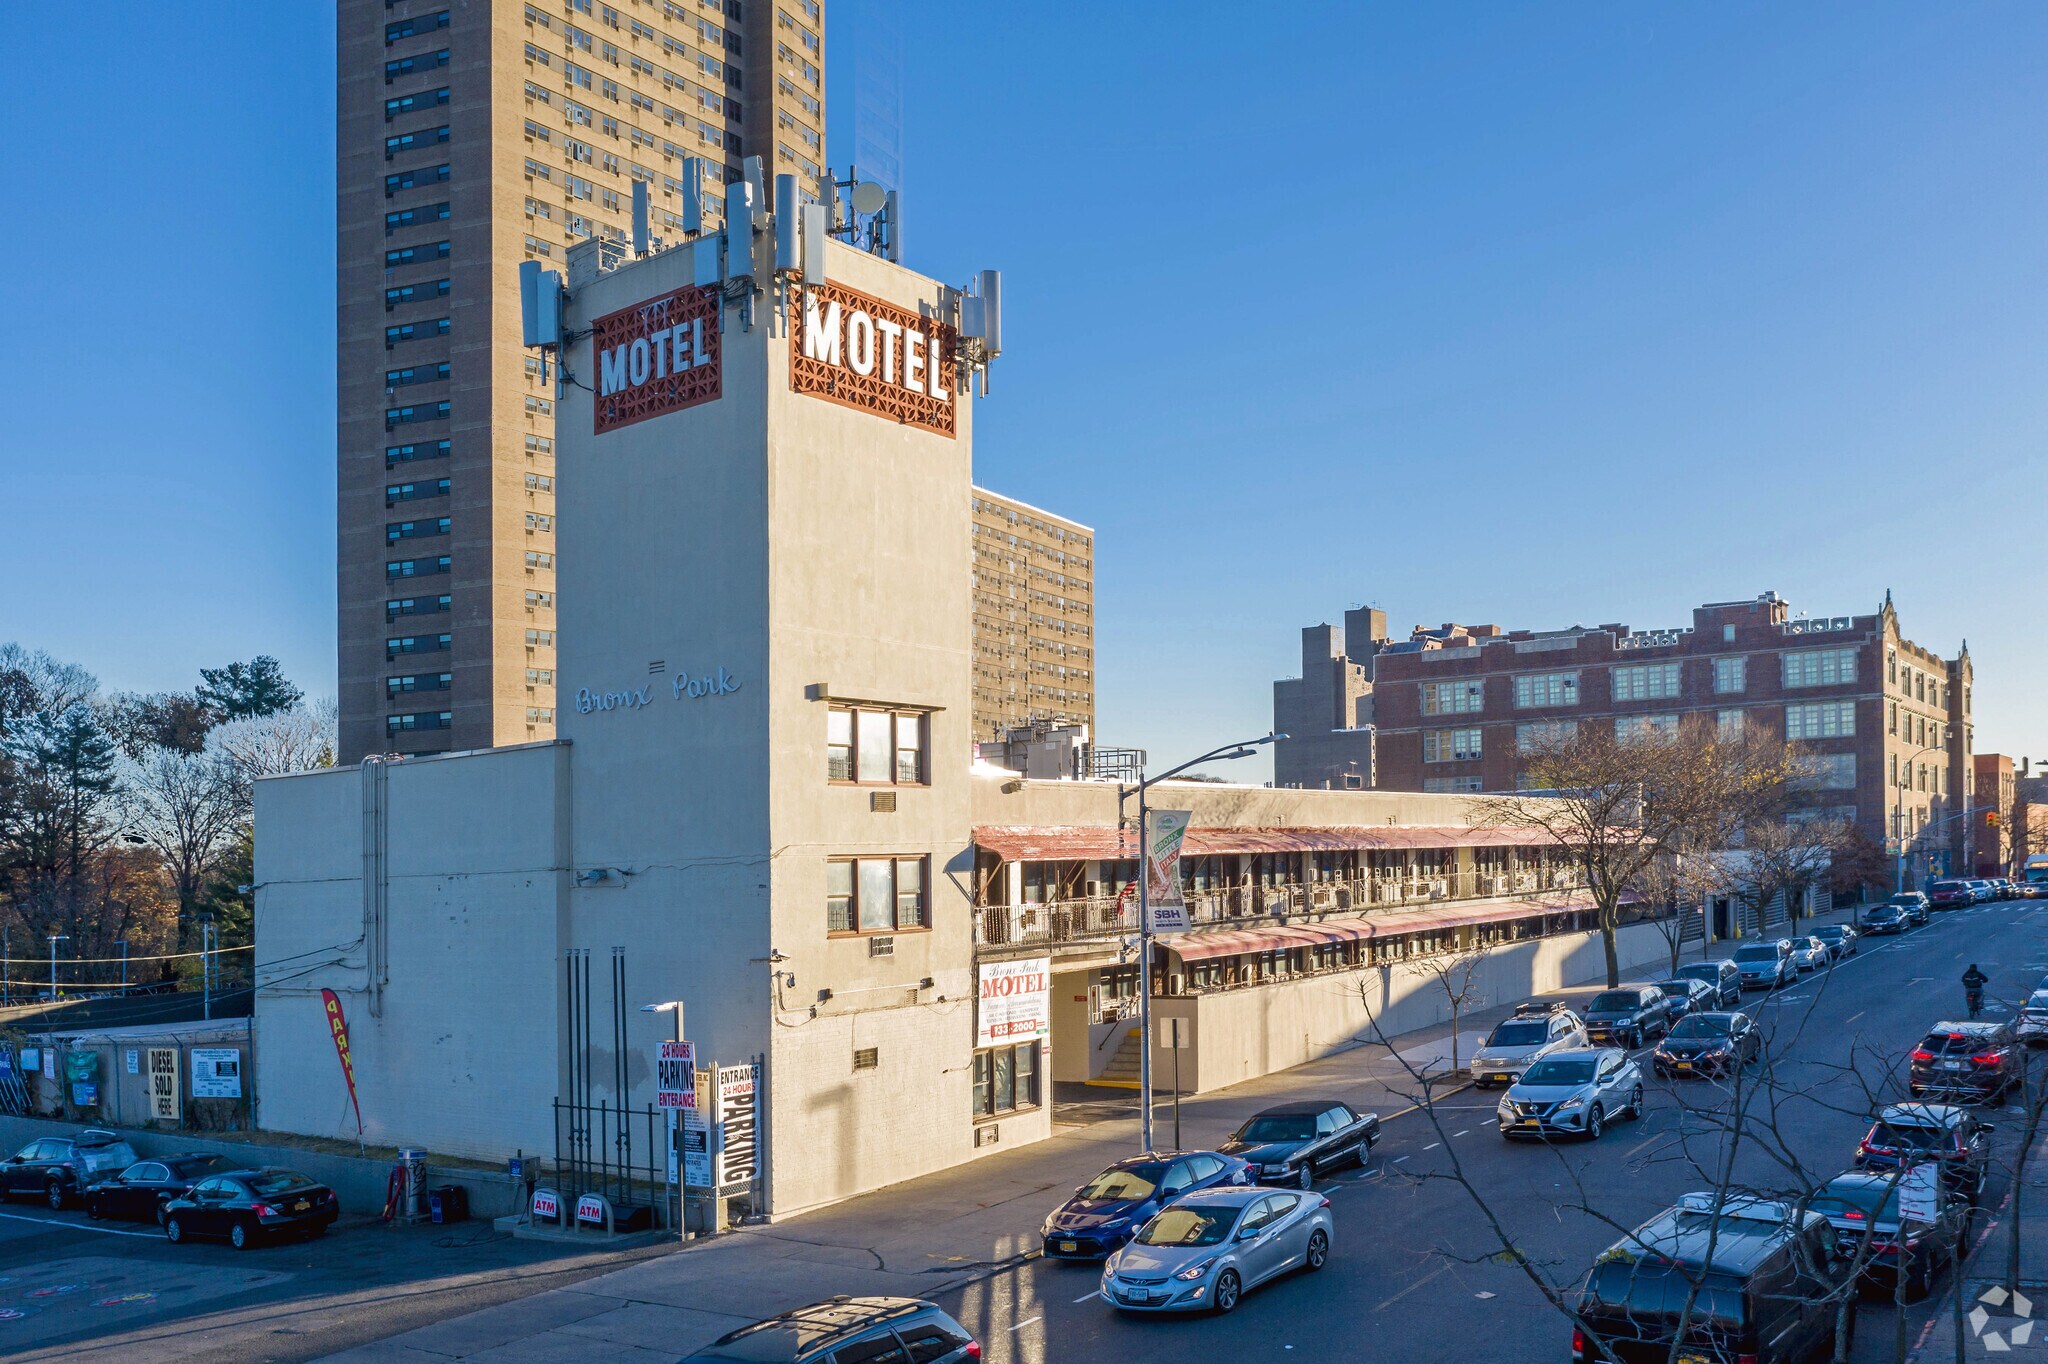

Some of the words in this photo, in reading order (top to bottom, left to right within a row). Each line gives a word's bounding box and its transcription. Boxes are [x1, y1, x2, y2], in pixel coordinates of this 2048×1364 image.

[804, 292, 949, 401] MOTEL
[600, 318, 712, 397] MOTEL
[575, 684, 654, 714] Bronx
[672, 665, 743, 700] Park
[1154, 831, 1180, 853] BRONX
[1157, 840, 1180, 861] LITTLE
[1160, 851, 1178, 870] ITALY
[1154, 909, 1181, 919] SBH
[989, 962, 1016, 977] Bronx
[1019, 960, 1040, 974] Park
[981, 972, 1047, 999] MOTEL
[662, 1045, 670, 1058] 24
[671, 1044, 691, 1058] HOURS
[151, 1051, 174, 1074] DIESEL
[658, 1060, 695, 1090] PARKING
[720, 1065, 759, 1085] ENTRANCE
[155, 1075, 173, 1096] SOLD
[723, 1086, 731, 1096] 24
[732, 1081, 756, 1094] HOURS
[157, 1097, 172, 1116] HERE
[659, 1093, 695, 1108] ENTERANCE
[723, 1092, 757, 1184] PARKING
[535, 1199, 555, 1213] ATM
[579, 1205, 600, 1219] ATM
